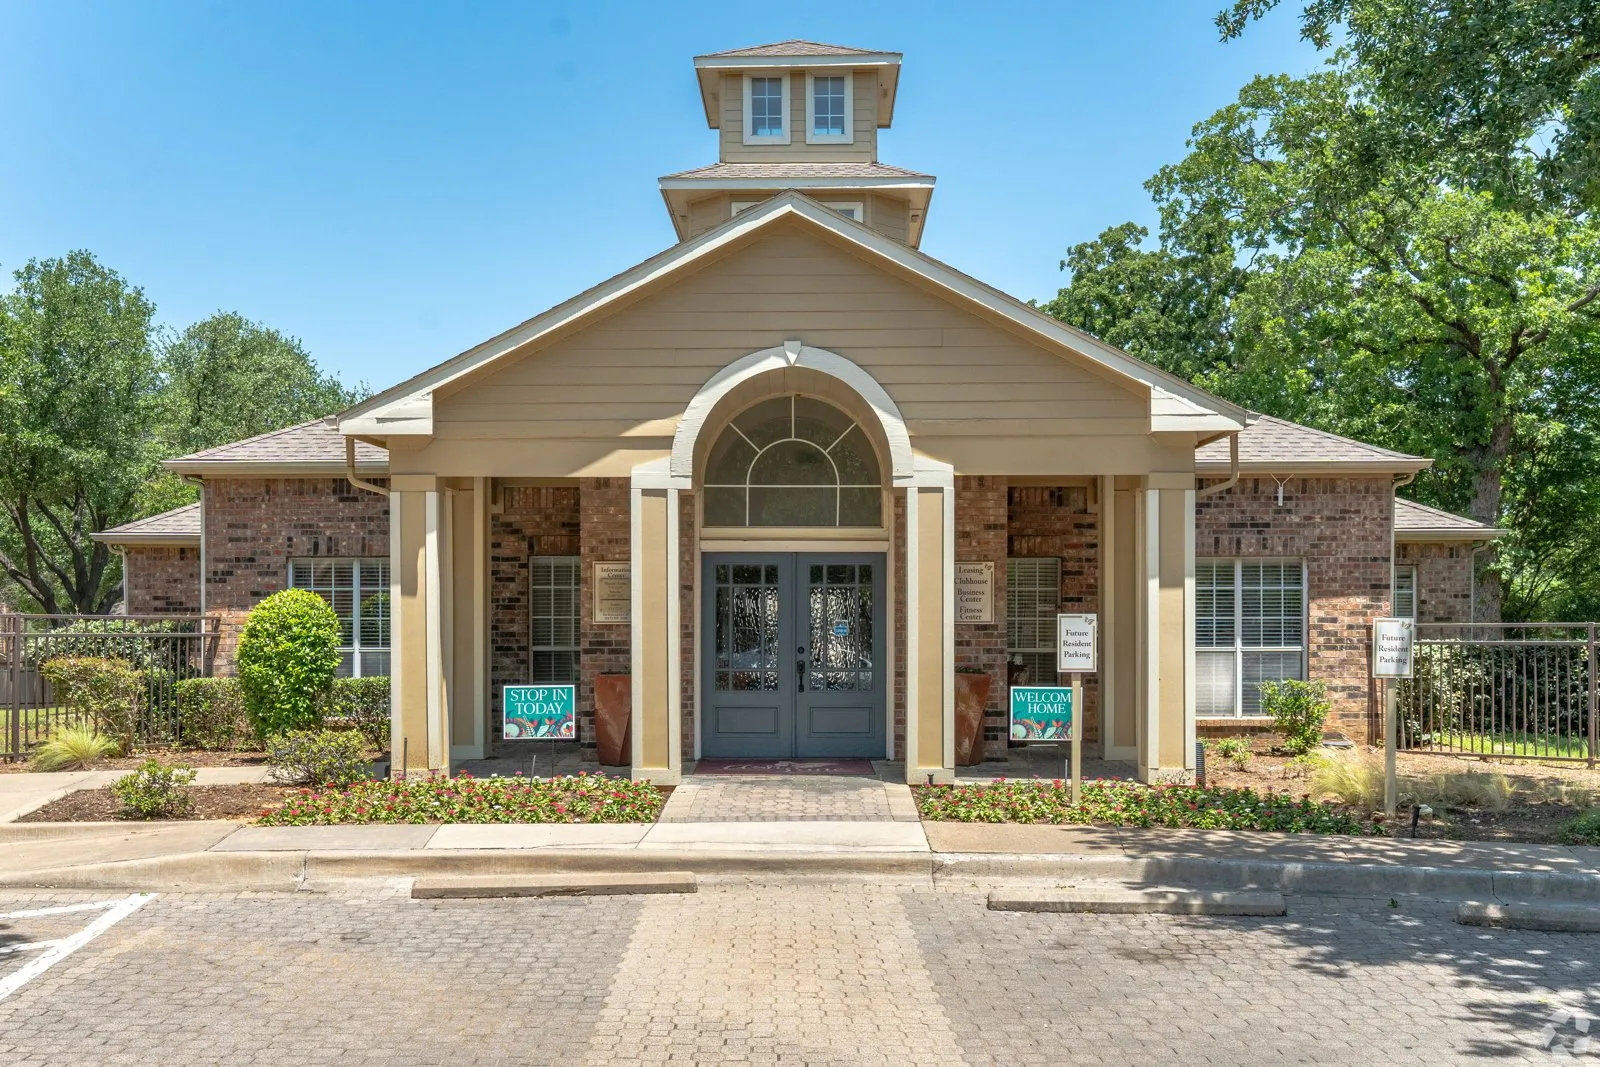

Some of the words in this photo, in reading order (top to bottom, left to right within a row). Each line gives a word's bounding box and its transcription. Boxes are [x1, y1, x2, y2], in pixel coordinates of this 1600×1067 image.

[958, 566, 984, 575] Leasing
[957, 588, 985, 596] Business
[960, 606, 983, 614] Fitness
[1065, 629, 1089, 637] Future
[1378, 645, 1409, 653] Resident
[1063, 650, 1091, 659] Parking
[1379, 656, 1408, 665] Parking
[510, 689, 548, 702] STOP
[552, 689, 568, 701] IN
[1014, 691, 1073, 703] WELCOM
[514, 702, 564, 714] TODAY
[1027, 703, 1066, 714] HOME
